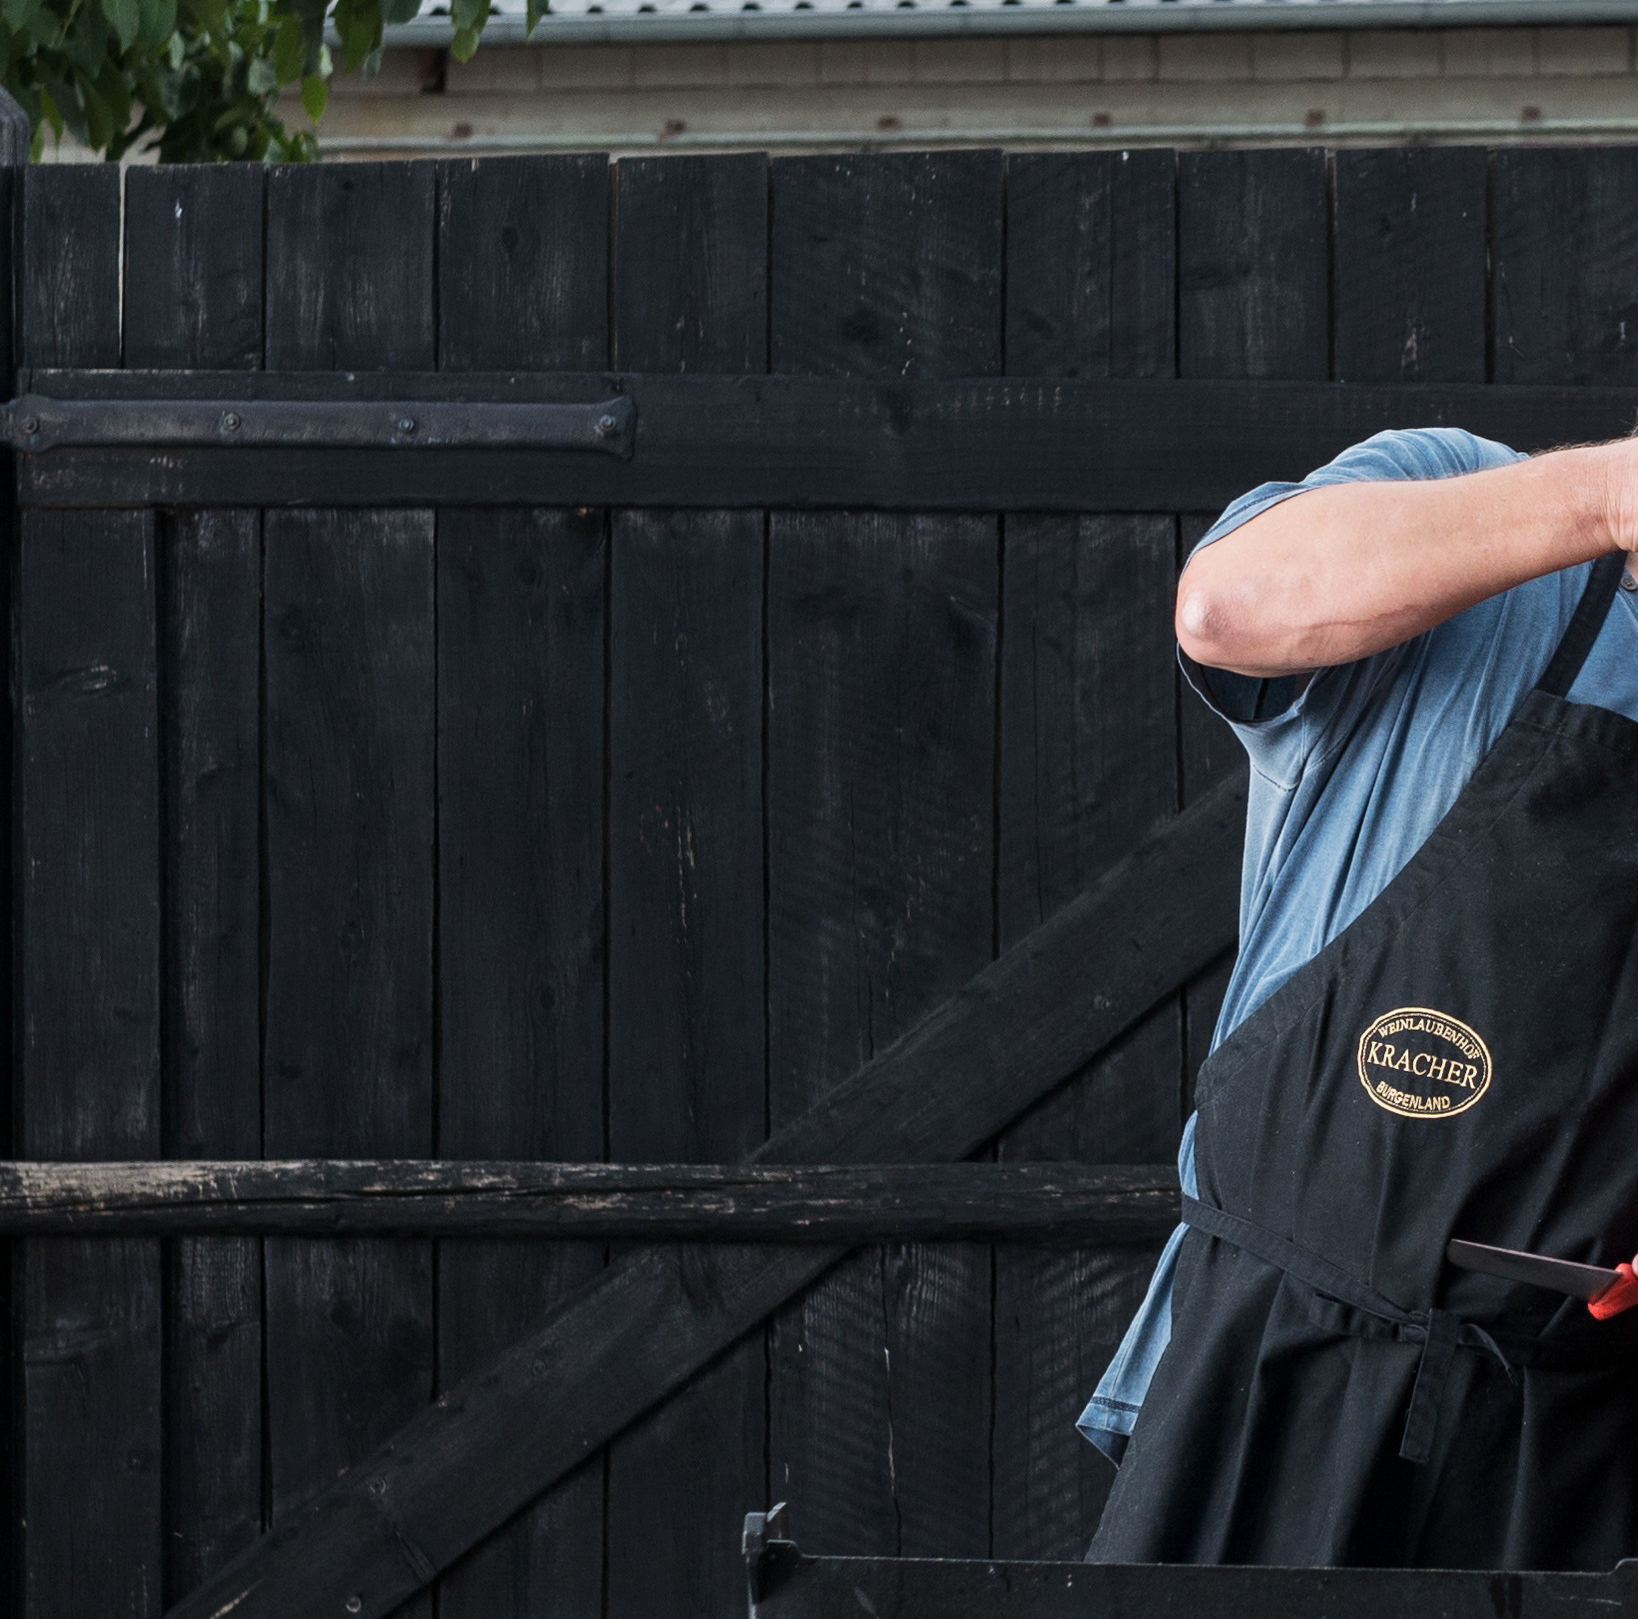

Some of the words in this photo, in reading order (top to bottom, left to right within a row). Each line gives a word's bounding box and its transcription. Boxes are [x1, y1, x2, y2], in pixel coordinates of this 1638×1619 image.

[1378, 1018, 1480, 1060] WEINLAUBENHOF
[1367, 1041, 1478, 1089] KRACHER
[1375, 1081, 1450, 1111] BURGENLAND
